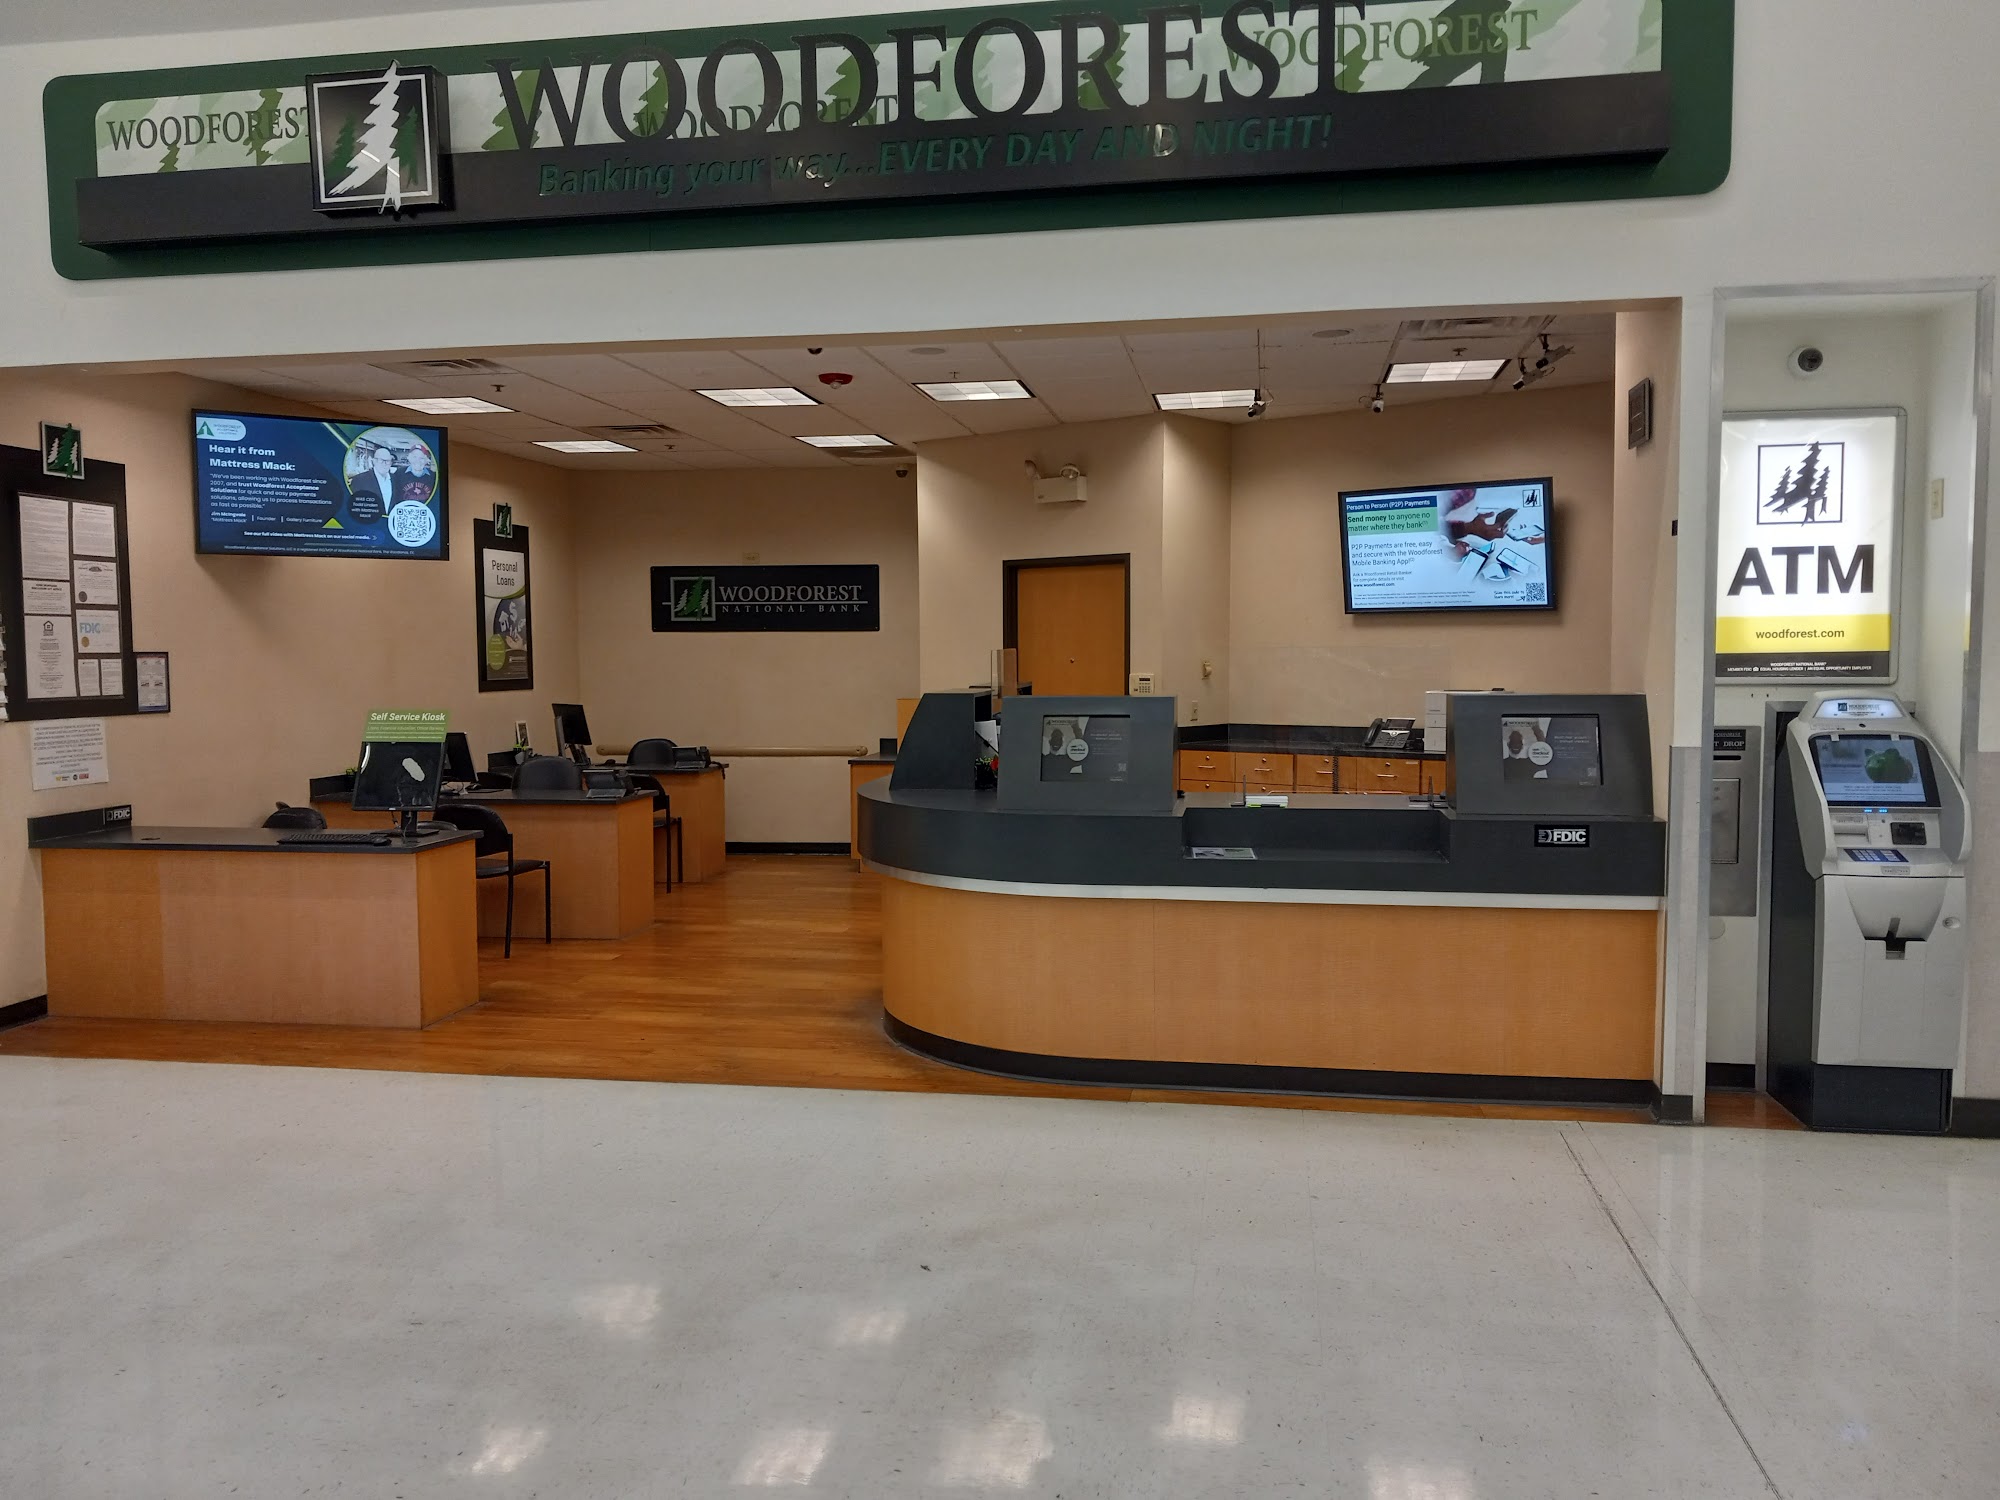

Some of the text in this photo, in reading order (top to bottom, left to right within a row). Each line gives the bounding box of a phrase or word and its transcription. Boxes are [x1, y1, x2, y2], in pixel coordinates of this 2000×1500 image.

[486, 0, 1366, 149] WOODFOREST
[539, 157, 674, 198] Banking
[683, 158, 765, 195] your
[1005, 128, 1086, 167] DAY
[1092, 122, 1180, 162] AND
[1193, 112, 1336, 156] NIGHT!
[209, 444, 275, 456] Hear it from
[210, 458, 296, 471] Mattress Mack:
[1404, 499, 1430, 507] Payments
[1347, 515, 1364, 523] Send
[1391, 523, 1405, 531] they
[1364, 542, 1393, 550] Payments
[1407, 548, 1443, 556] Woodforest
[491, 559, 518, 573] Personal
[1726, 544, 1876, 597] ATM
[496, 574, 515, 587] Loans
[719, 585, 862, 602] WOODFOREST
[722, 604, 860, 613] NATIONAL BANK
[79, 622, 101, 633] FDIC
[1755, 628, 1845, 640] woodforest.com
[370, 712, 445, 721] Self Service Kiosk
[114, 810, 130, 820] FDIC
[1553, 831, 1586, 842] FDIC
